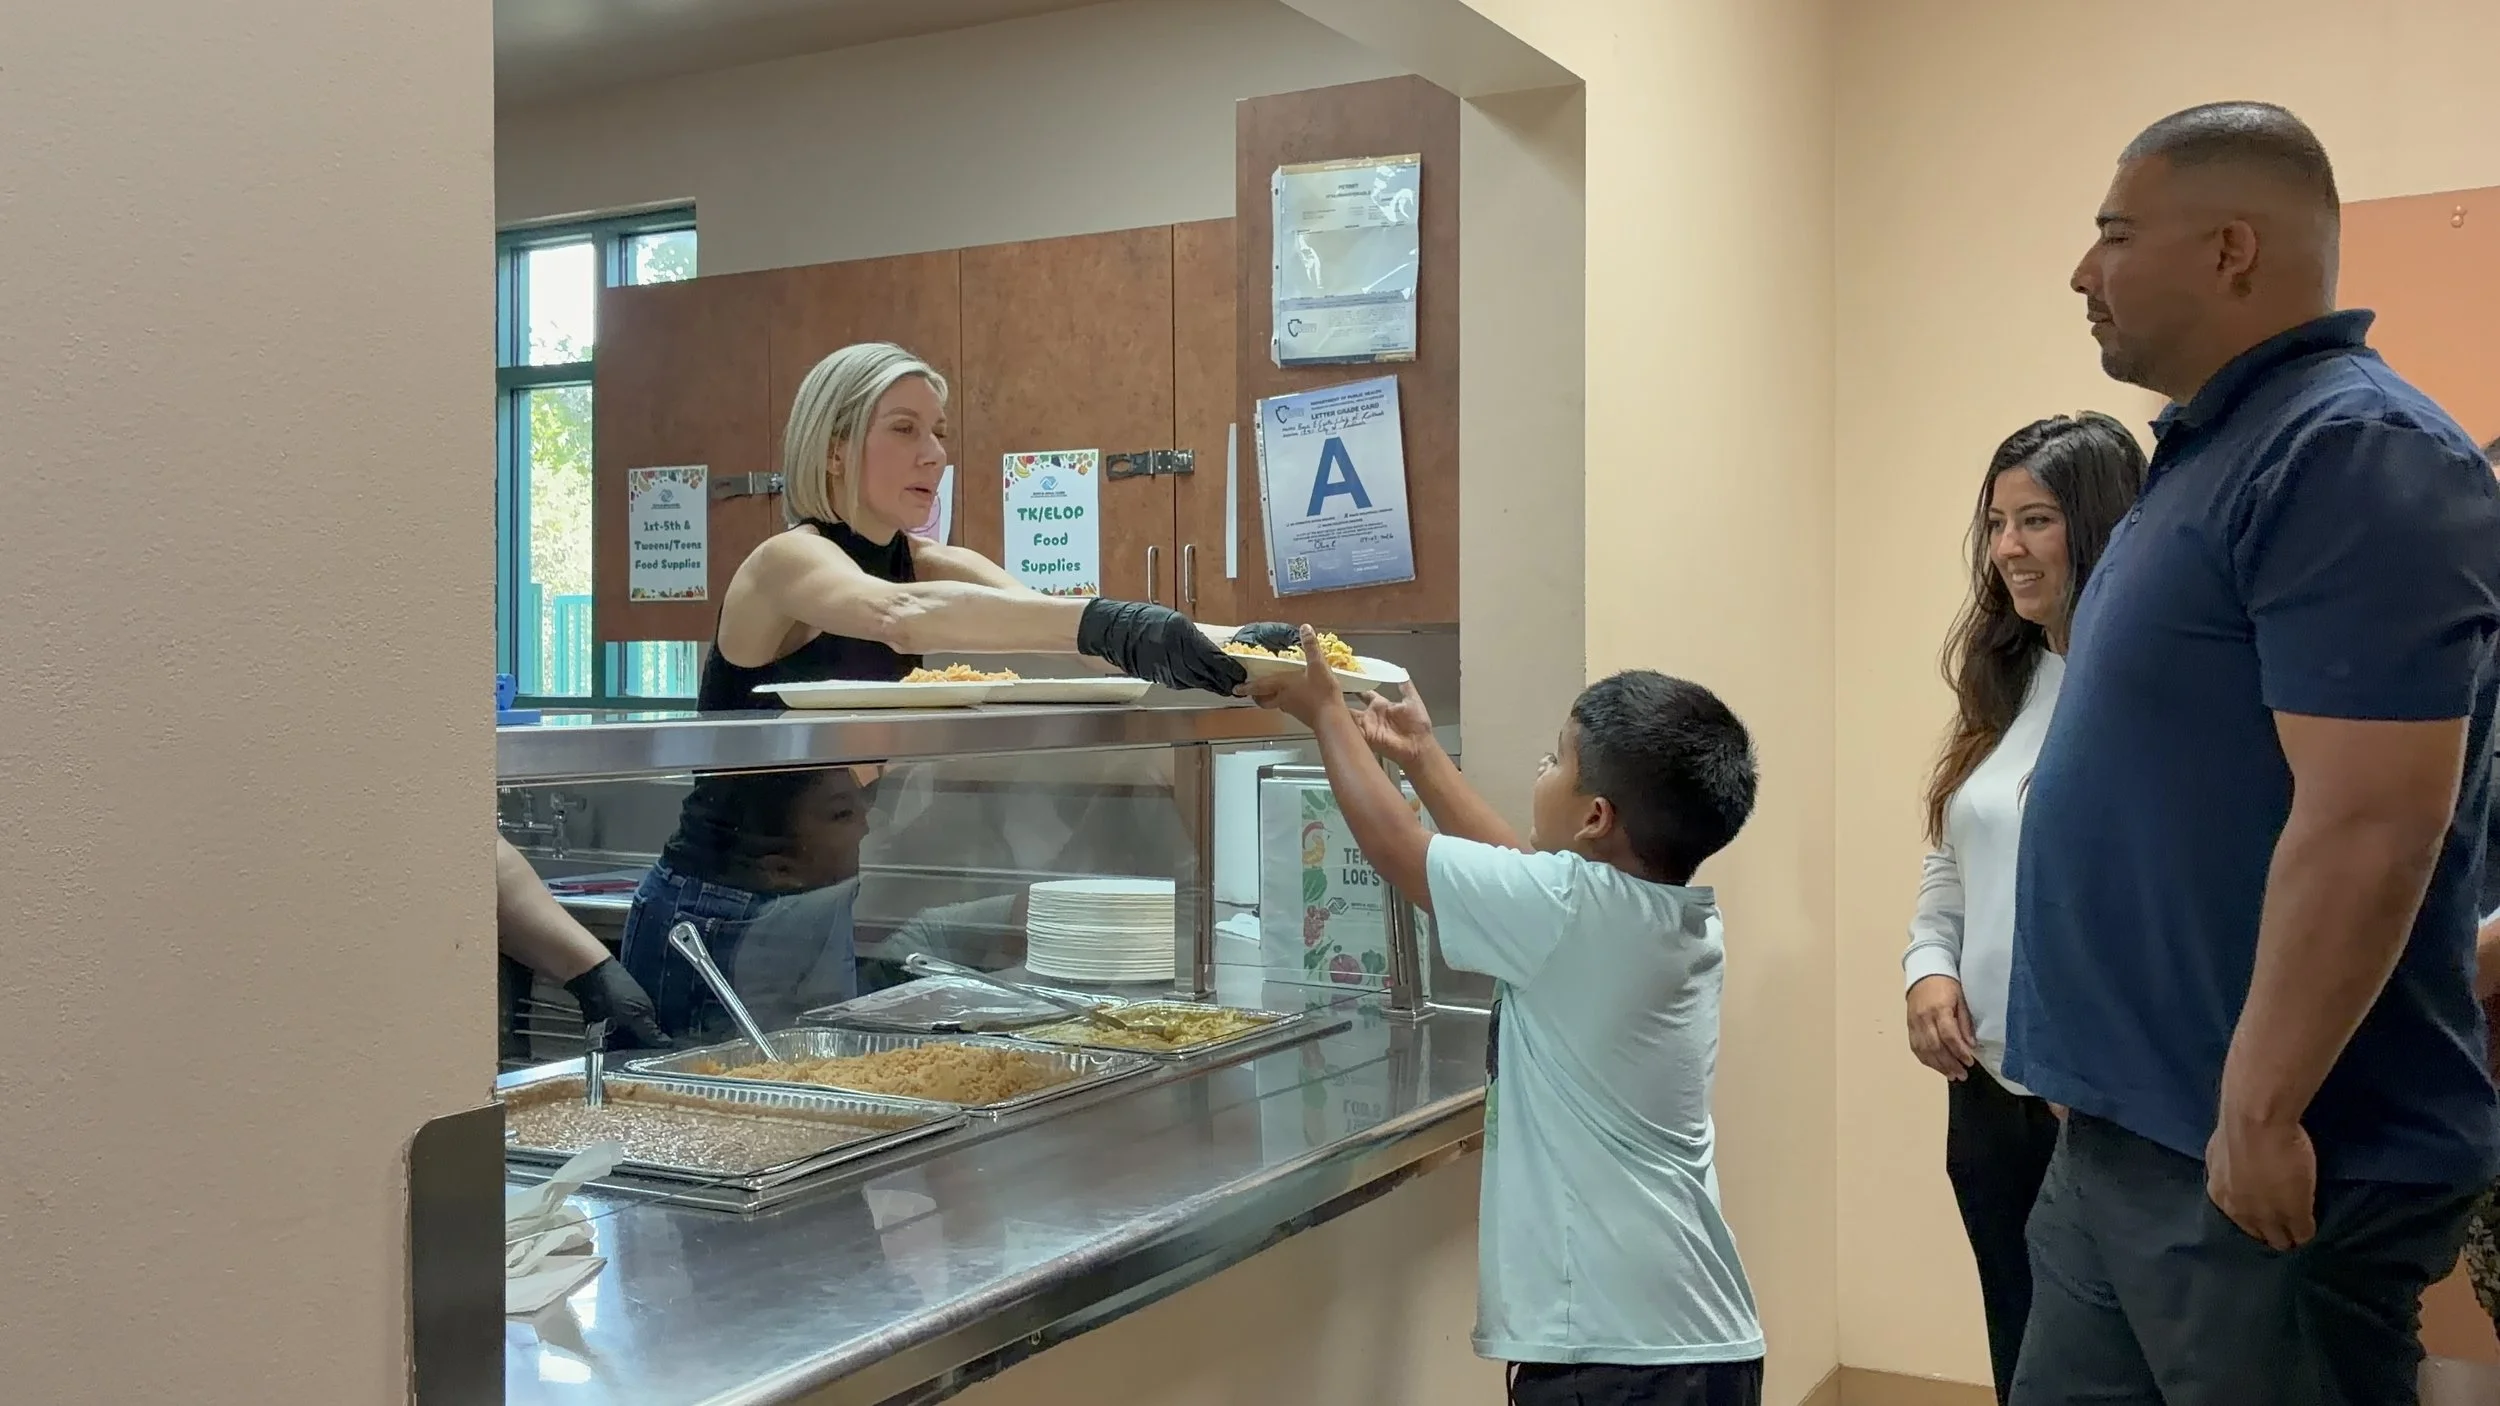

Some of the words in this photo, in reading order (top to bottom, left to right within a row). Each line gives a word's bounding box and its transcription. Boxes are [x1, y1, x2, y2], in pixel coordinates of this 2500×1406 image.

[1311, 410, 1336, 420] LETTER
[1337, 405, 1360, 415] GRADE
[1360, 401, 1380, 411] CARD
[1306, 436, 1373, 518] A
[1017, 505, 1084, 523] TK/ELOP
[643, 520, 681, 531] 1st-5th
[684, 519, 691, 530] &
[634, 539, 702, 551] Tweens/Teens
[1033, 532, 1068, 546] Food
[635, 559, 658, 570] Food
[661, 558, 701, 571] Supplies
[1021, 558, 1081, 575] Supplies
[1342, 868, 1380, 887] LOG'S
